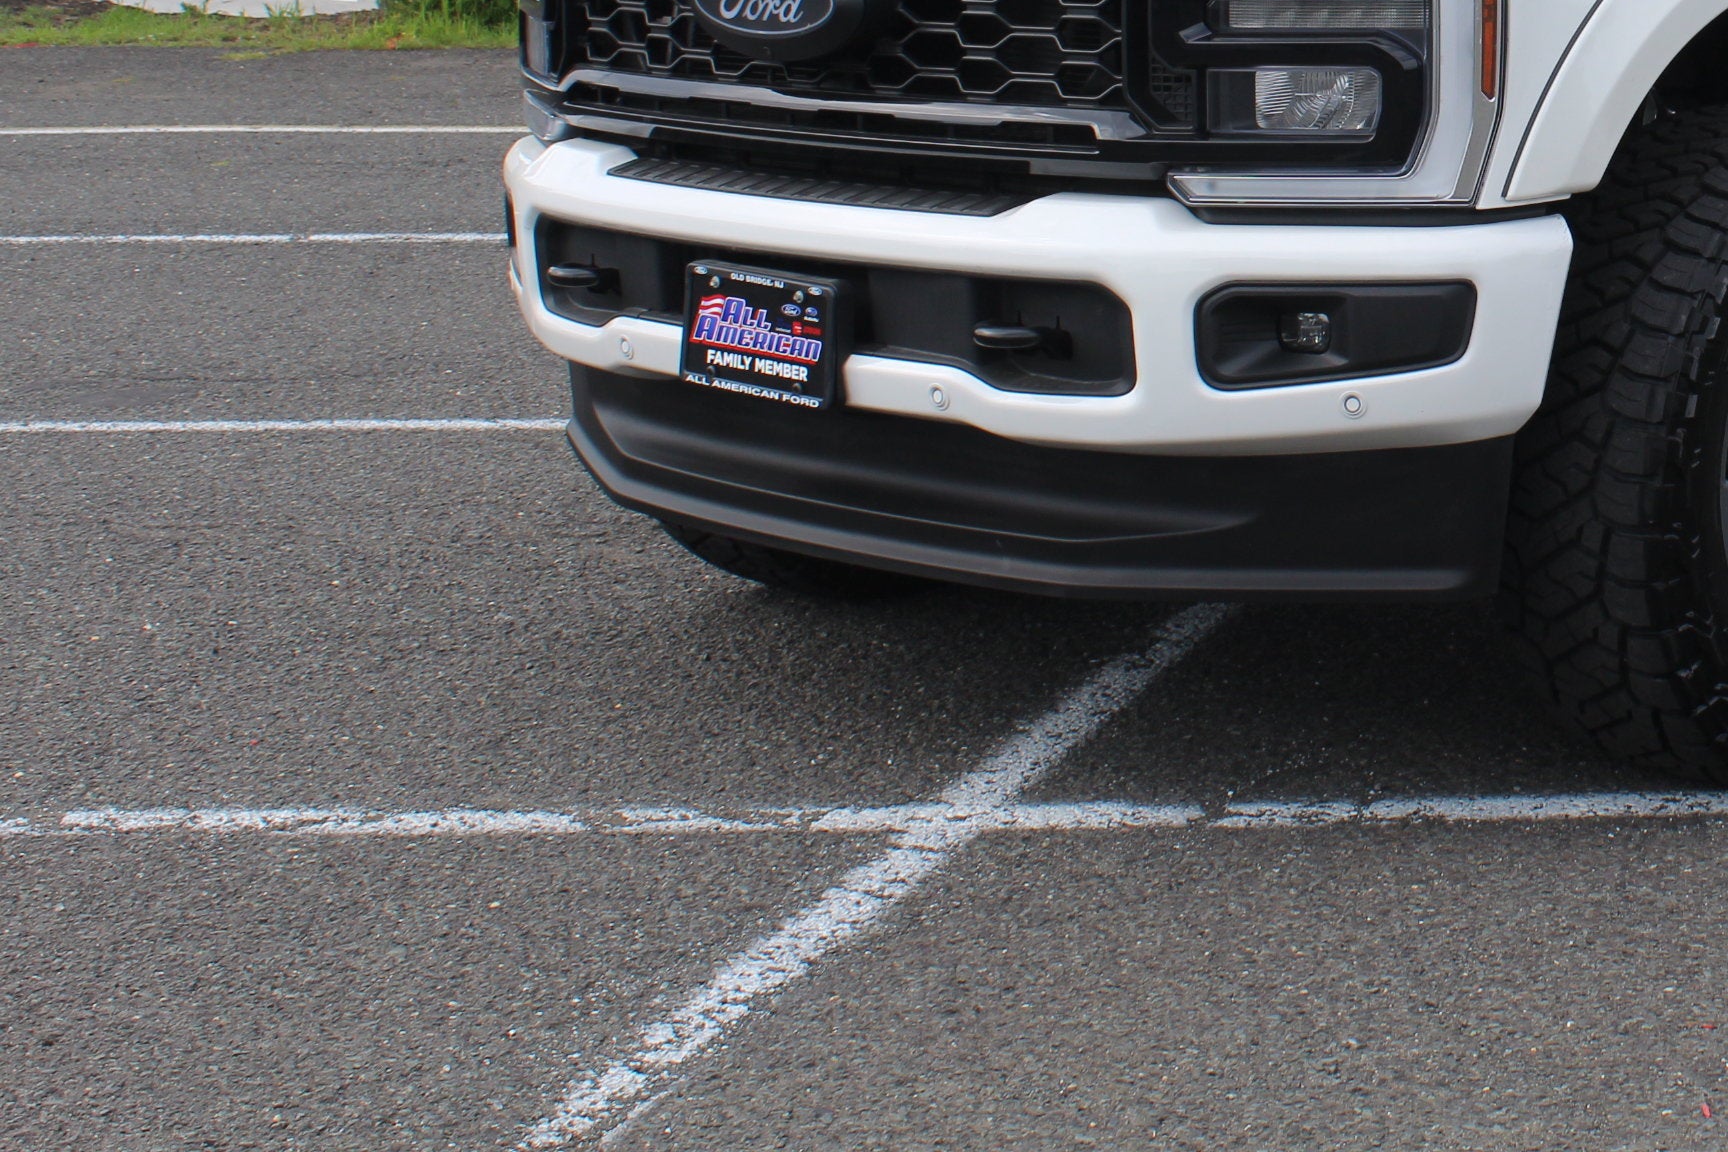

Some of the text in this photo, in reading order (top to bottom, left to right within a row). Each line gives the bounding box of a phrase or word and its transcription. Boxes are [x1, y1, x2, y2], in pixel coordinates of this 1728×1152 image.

[730, 272, 745, 282] OLD
[722, 297, 771, 330] ALL
[693, 314, 821, 361] AMERICAN
[707, 350, 808, 381] FAMILY MEMBER
[685, 374, 820, 408] ALL AMERICAN FORD
